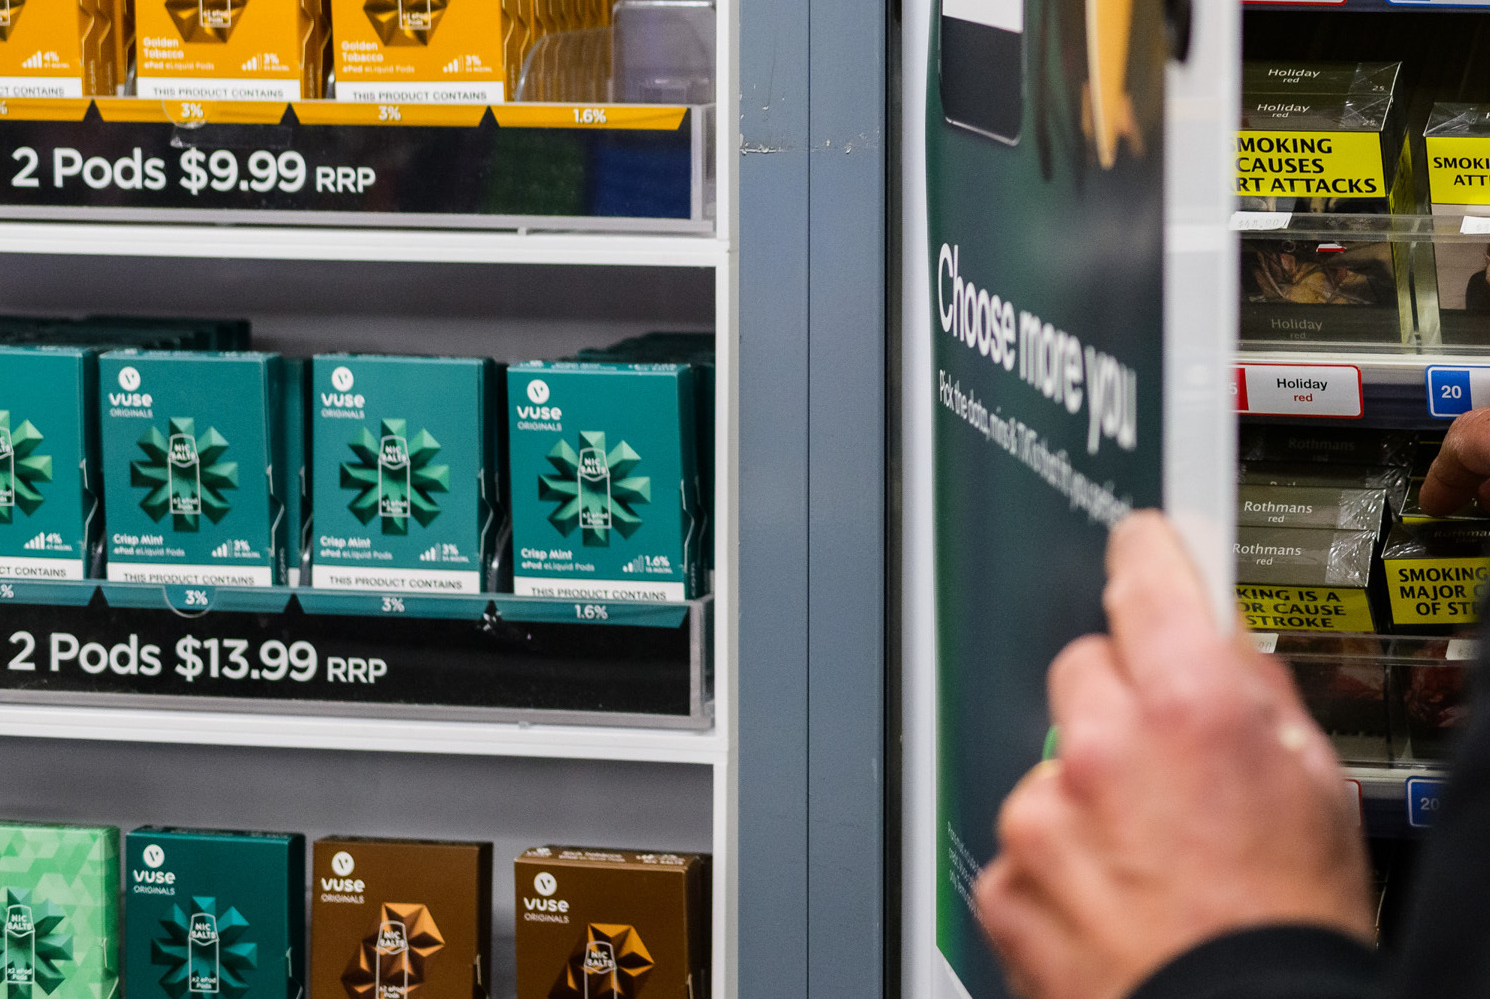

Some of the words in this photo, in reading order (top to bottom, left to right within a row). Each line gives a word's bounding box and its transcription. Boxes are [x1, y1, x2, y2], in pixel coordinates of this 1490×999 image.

[143, 37, 179, 48] Golden
[342, 41, 378, 51] Golden
[43, 51, 59, 62] 4%
[143, 49, 184, 59] Tobacco
[342, 52, 383, 62] Tobacco
[1268, 68, 1320, 79] Holiday
[181, 103, 204, 118] 3%
[378, 106, 401, 121] 3%
[1257, 104, 1310, 114] Holiday
[573, 109, 607, 124] 1.6%
[1230, 137, 1332, 153] MOKING
[11, 147, 39, 188] 2
[54, 147, 167, 189] Pods
[179, 147, 306, 196] $9.99
[315, 166, 376, 193] RRP
[1235, 157, 1324, 173] CAUSES
[1271, 177, 1377, 193] ATTACKS
[938, 243, 1016, 371] Choose
[1020, 310, 1083, 415] more
[1084, 345, 1137, 456] you
[1276, 377, 1328, 391] Holiday
[1293, 392, 1313, 402] red
[1441, 385, 1462, 399] 20
[109, 393, 152, 407] vuse
[321, 393, 365, 408] vuse
[517, 405, 561, 420] vuse
[517, 421, 562, 432] ORIGINALS
[1244, 501, 1312, 514] Rothmans
[1398, 567, 1488, 582] SMOKING
[329, 576, 353, 585] THIS
[357, 577, 405, 587] PRODUCT
[409, 579, 462, 589] CONTAINS
[185, 590, 208, 606] 3%
[1298, 591, 1318, 601] IS
[1326, 592, 1342, 602] A
[1400, 585, 1466, 601] MAJOR
[382, 597, 405, 613] 3%
[1273, 603, 1346, 616] CAUSE
[1416, 602, 1441, 615] OF
[575, 605, 608, 620] 1.6%
[1245, 615, 1334, 627] STROKE
[7, 630, 36, 671] 2
[50, 632, 162, 676] Pods
[174, 634, 318, 682] $13.99
[327, 657, 388, 684] RRP
[133, 869, 176, 885] vuse
[134, 885, 175, 895] ORIGINALS
[321, 877, 365, 893] vuse
[523, 897, 569, 913] vuse
[11, 914, 27, 923] NIC
[524, 913, 569, 923] ORIGINALS
[195, 923, 211, 931] NIC
[192, 930, 216, 939] SALTS
